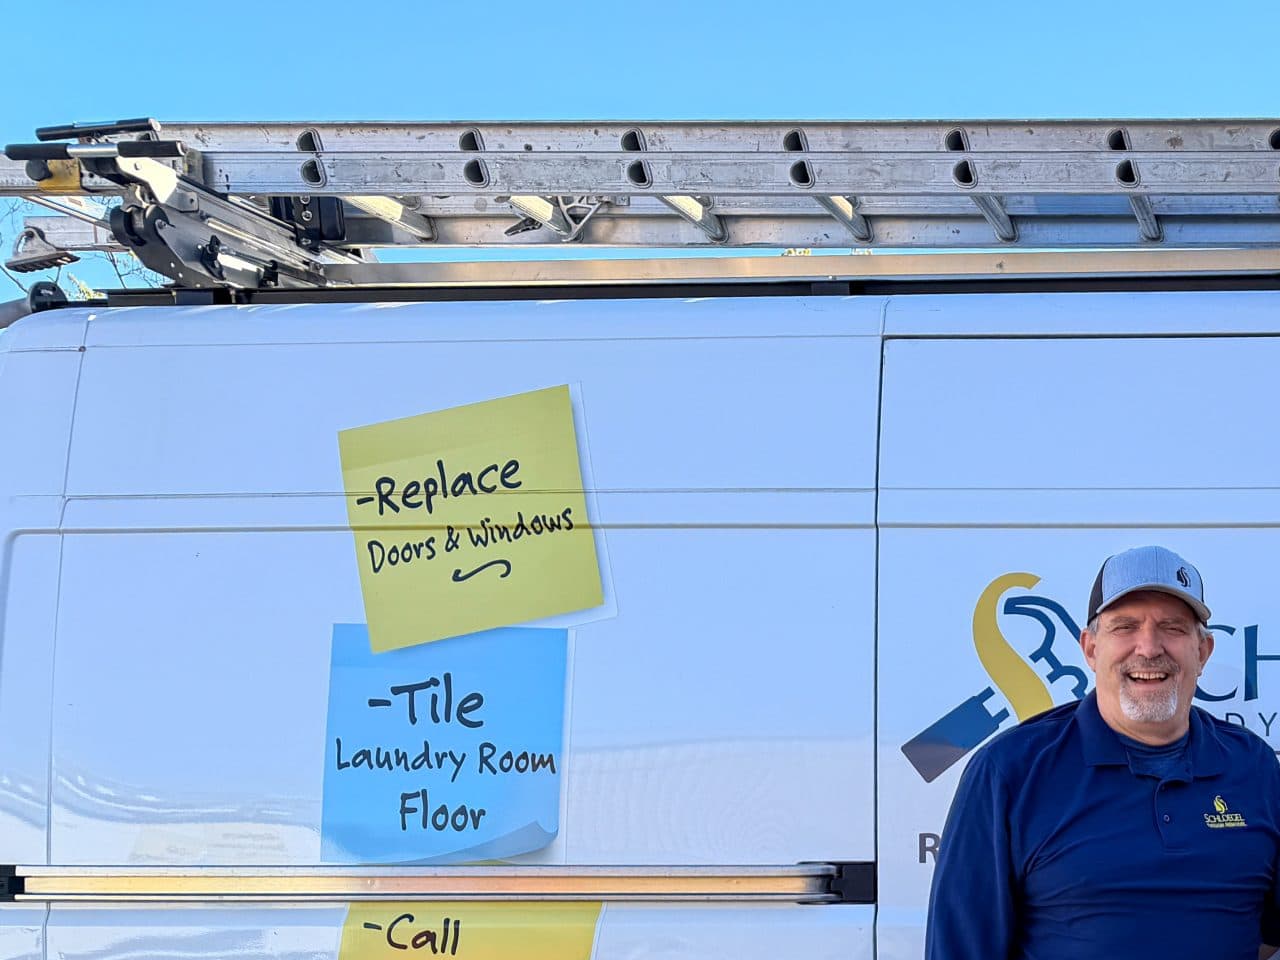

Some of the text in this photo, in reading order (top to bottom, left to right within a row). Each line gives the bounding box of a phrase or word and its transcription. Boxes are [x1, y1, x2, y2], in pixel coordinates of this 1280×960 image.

[356, 459, 522, 515] -Replace
[367, 507, 574, 573] Doors & Windows
[368, 672, 484, 728] -Tile
[335, 738, 557, 783] Laundry Room
[400, 788, 486, 832] Floor
